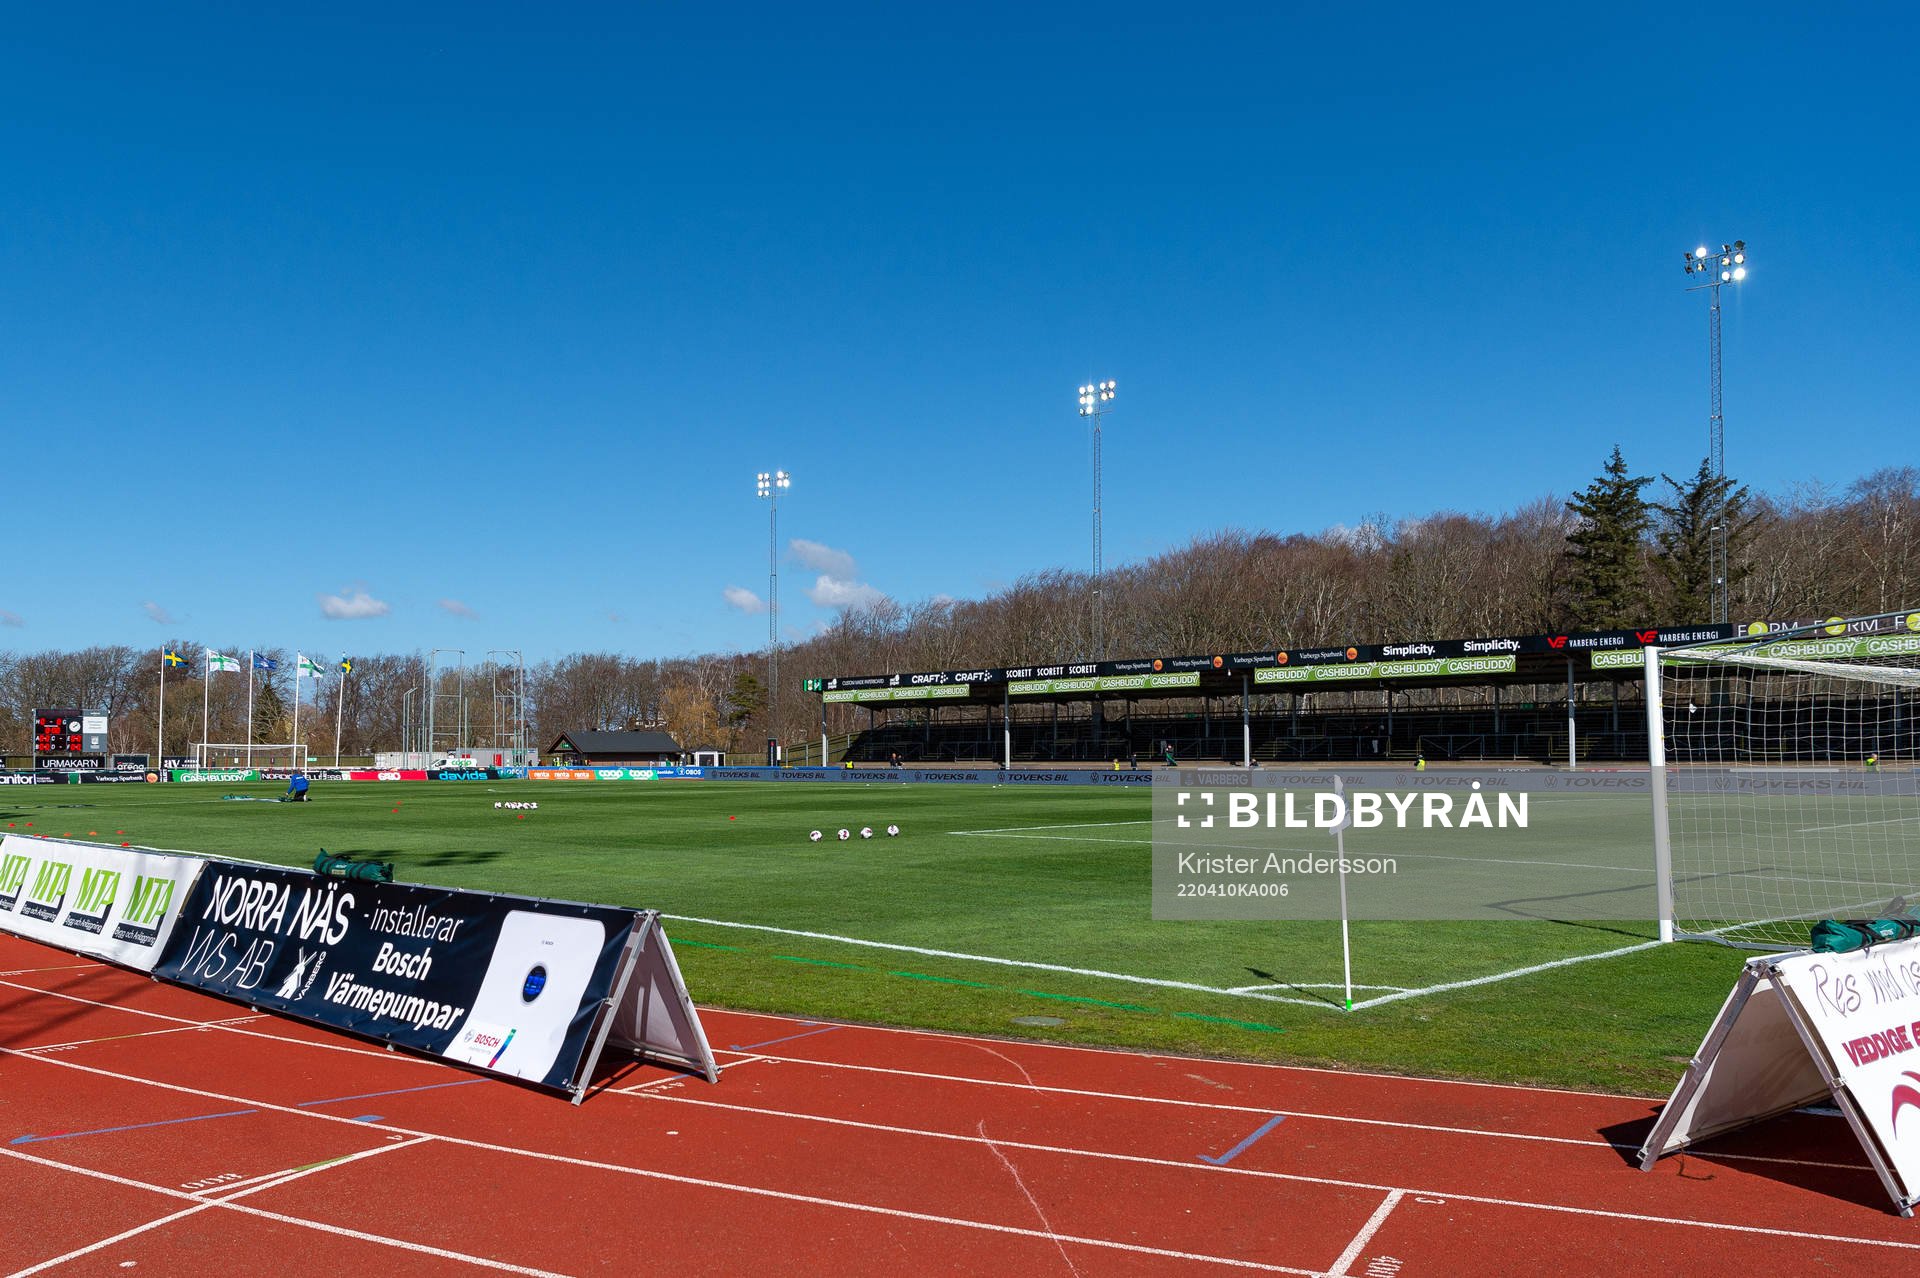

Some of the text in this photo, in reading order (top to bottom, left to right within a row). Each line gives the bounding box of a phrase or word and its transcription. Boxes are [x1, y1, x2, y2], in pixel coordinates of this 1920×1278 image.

[1659, 632, 1690, 642] VARBERG
[1692, 630, 1719, 640] ENERGI
[1569, 638, 1598, 648] VARBERG
[1600, 637, 1624, 646] ENERGI
[1870, 640, 1920, 652] CASHB
[1321, 650, 1344, 658] Sparbank
[1771, 642, 1854, 656] CASHBUDDY
[1594, 652, 1645, 666] CASHBU
[1006, 664, 1096, 678] SCORETT SCORETT SCORETT
[1380, 662, 1440, 674] CASHBUDDY
[1450, 659, 1513, 672] CASHBUDDY
[912, 672, 984, 684] CRAFT CRAFT
[1256, 668, 1308, 681] CASHBUDDY
[1317, 666, 1372, 678] CASHBUDDY
[1054, 680, 1095, 690] CASHBUDDY
[1102, 678, 1145, 688] CASHBUDDY
[1152, 676, 1198, 686] CASHBUDDY
[894, 689, 928, 698] CASHBUDDY
[933, 687, 968, 696] CASHBUDDY
[1010, 683, 1048, 692] CASHBUDDY
[858, 691, 890, 699] CASHBUDDY
[42, 760, 98, 768] URMAKAR'N
[438, 770, 488, 780] davids
[1103, 774, 1152, 782] TOVEKS
[1198, 774, 1248, 785] VARBERG
[1280, 776, 1366, 784] TOVEK BIL
[1486, 777, 1509, 786] BIL
[1564, 778, 1646, 787] TOVEKS
[1738, 779, 1870, 790] TOVEKS BIL
[29, 860, 73, 904] MTA
[73, 867, 121, 913] MTA
[122, 875, 176, 924] MTA
[203, 874, 354, 946] NORRA NÄS
[222, 937, 274, 989] AB
[372, 942, 432, 981] Bosch
[295, 950, 326, 1000] VARBERG
[1810, 964, 1862, 1017] Res
[324, 972, 465, 1031] Värmepumpar
[474, 1034, 501, 1048] BOSCH
[1842, 1025, 1914, 1068] VEDDIGE
